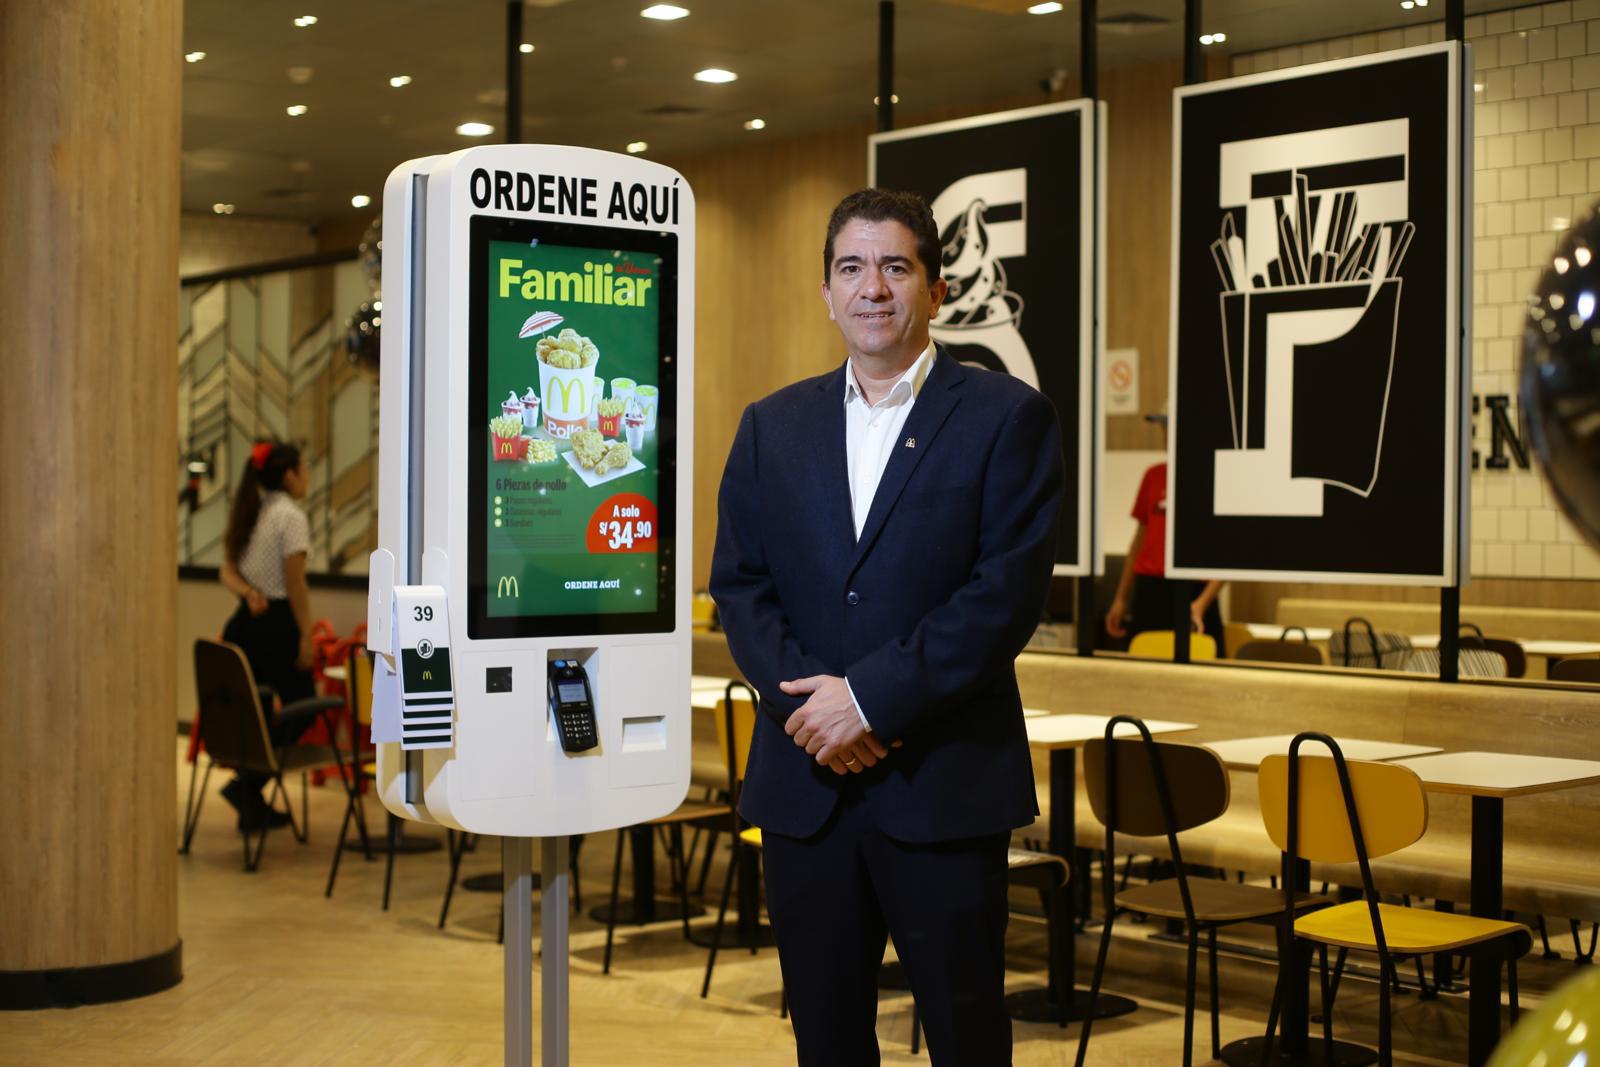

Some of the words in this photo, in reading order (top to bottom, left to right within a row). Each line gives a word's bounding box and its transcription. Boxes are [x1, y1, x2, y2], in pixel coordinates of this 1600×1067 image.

[470, 167, 597, 218] ORDENE
[607, 178, 680, 226] AQUÍ
[499, 258, 652, 308] Familiar
[612, 504, 620, 518] A
[621, 504, 640, 518] solo
[564, 580, 599, 590] ORDENE
[599, 578, 621, 589] AQUÍ
[413, 606, 433, 622] 39
